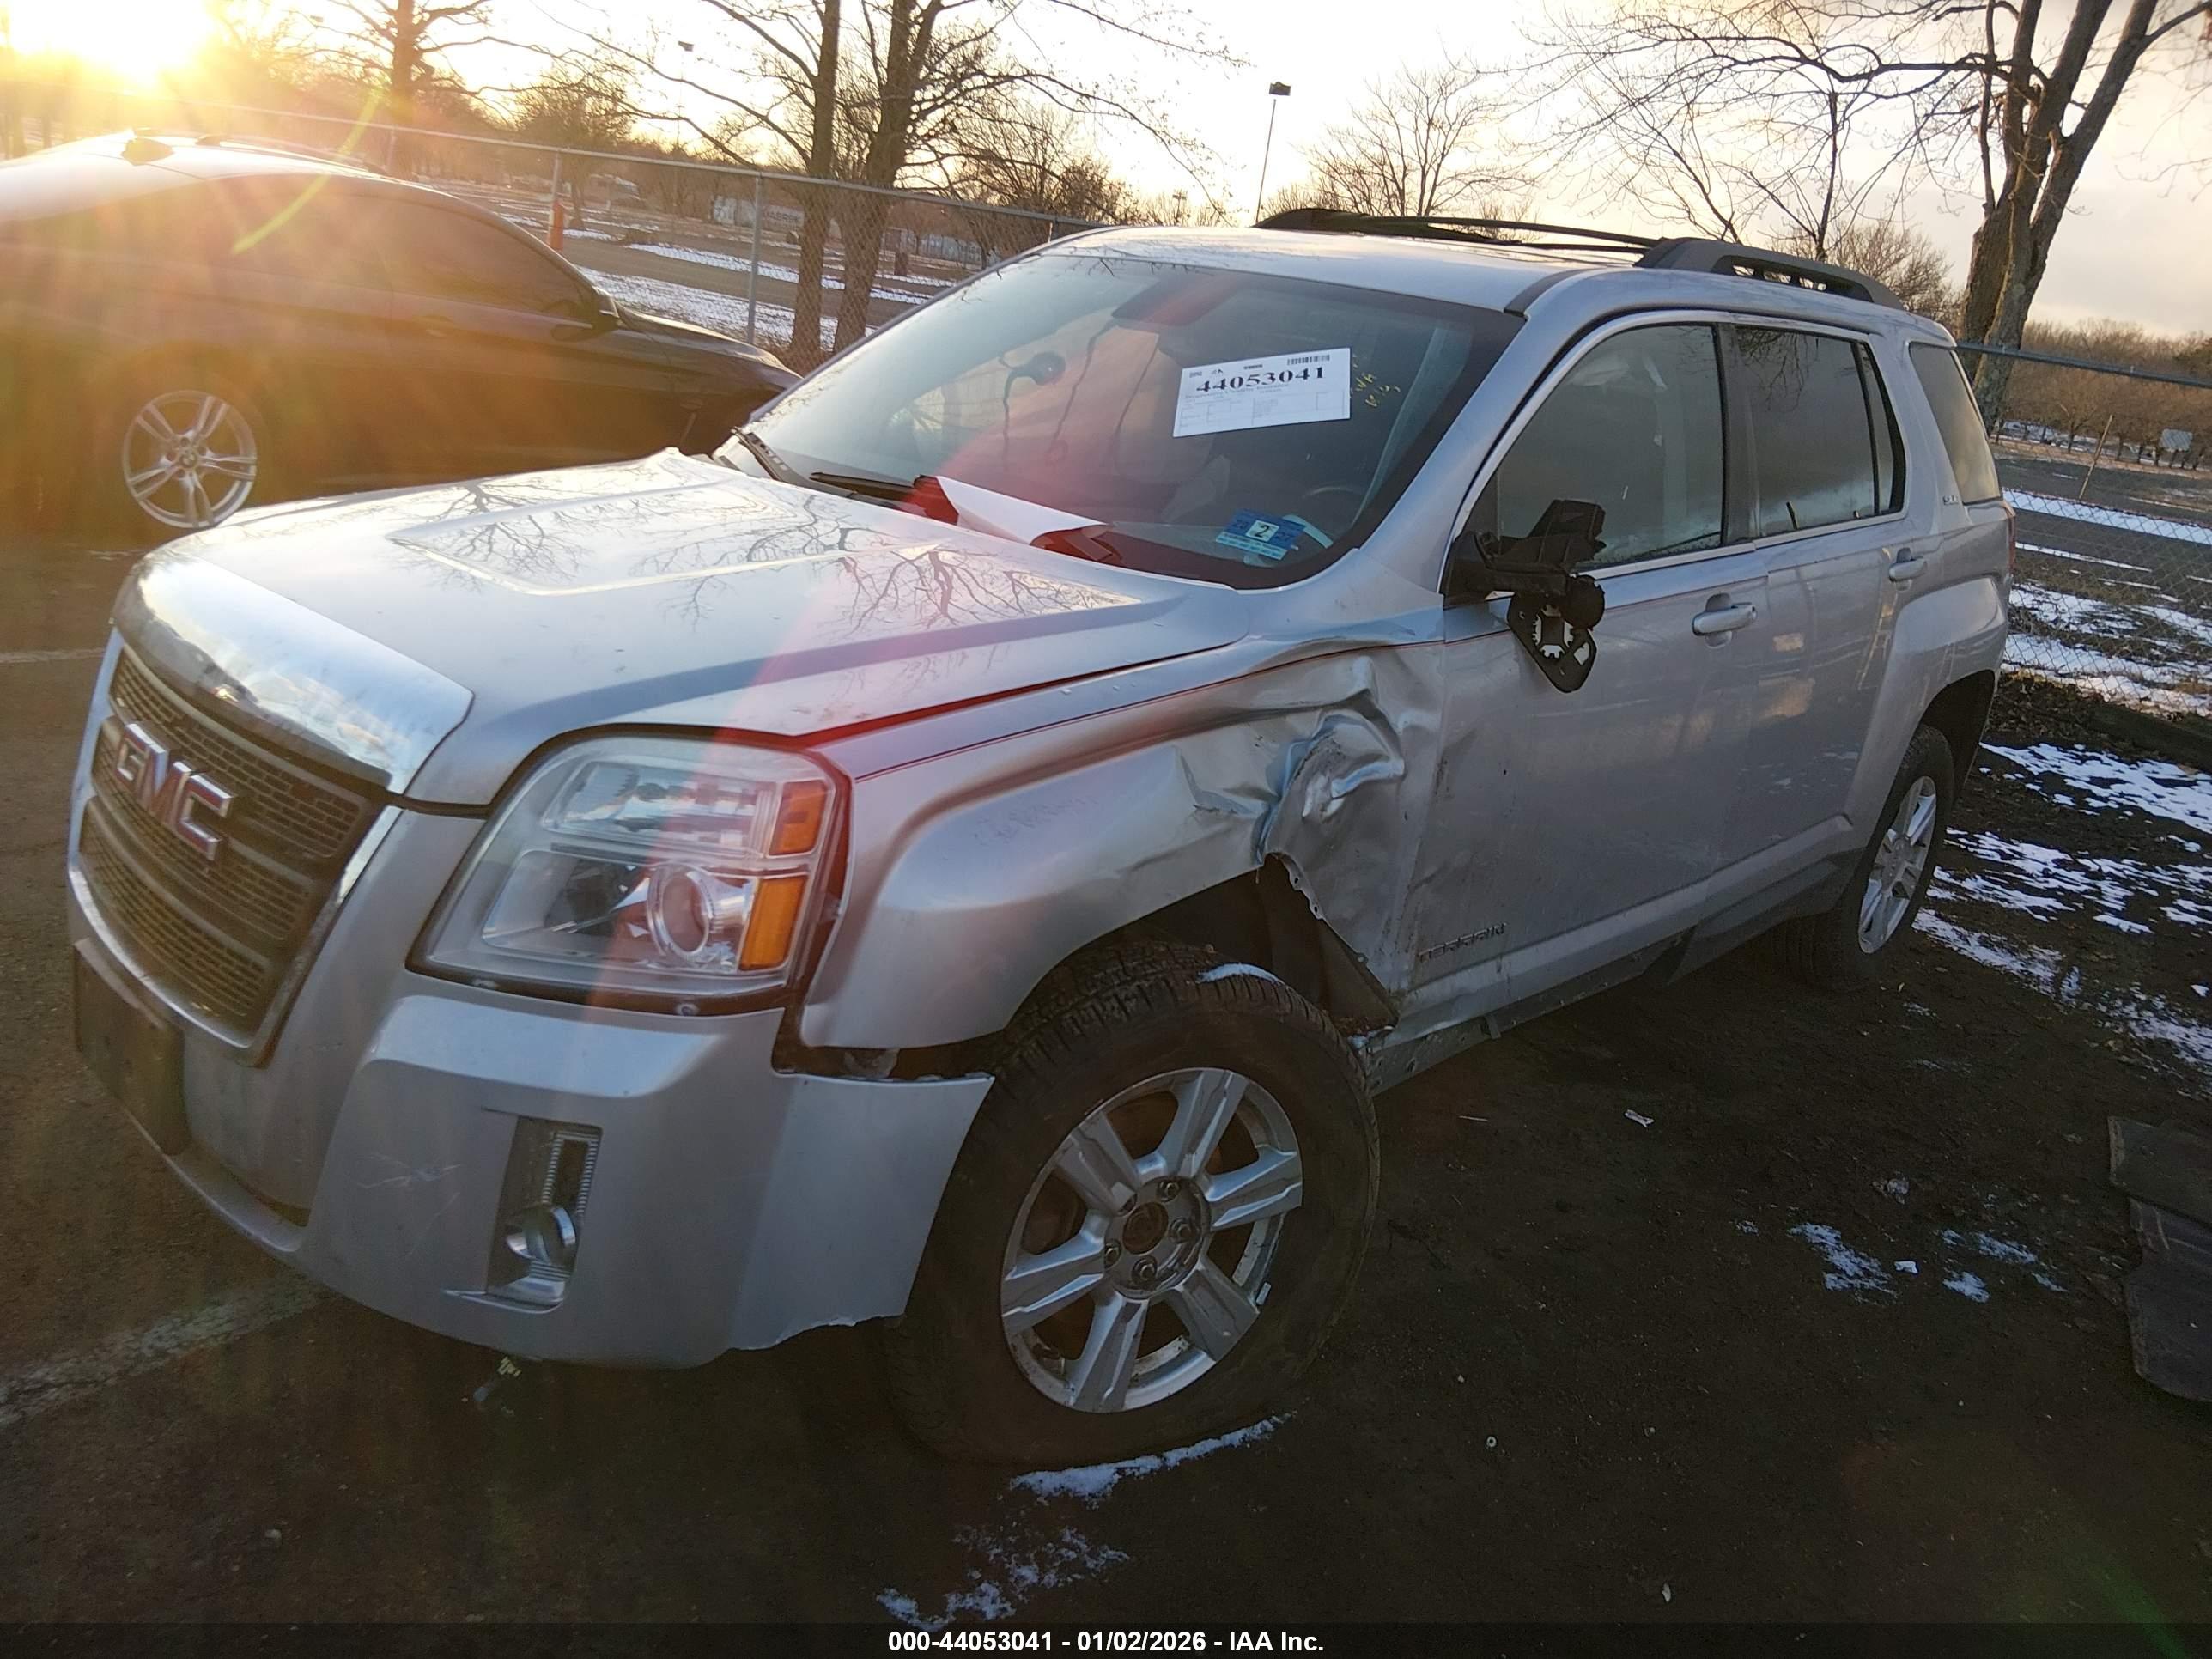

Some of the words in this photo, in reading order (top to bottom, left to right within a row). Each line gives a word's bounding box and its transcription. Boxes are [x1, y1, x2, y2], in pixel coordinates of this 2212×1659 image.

[1196, 366, 1326, 393] 44053041
[1255, 524, 1270, 538] 2
[116, 723, 234, 860] GMC
